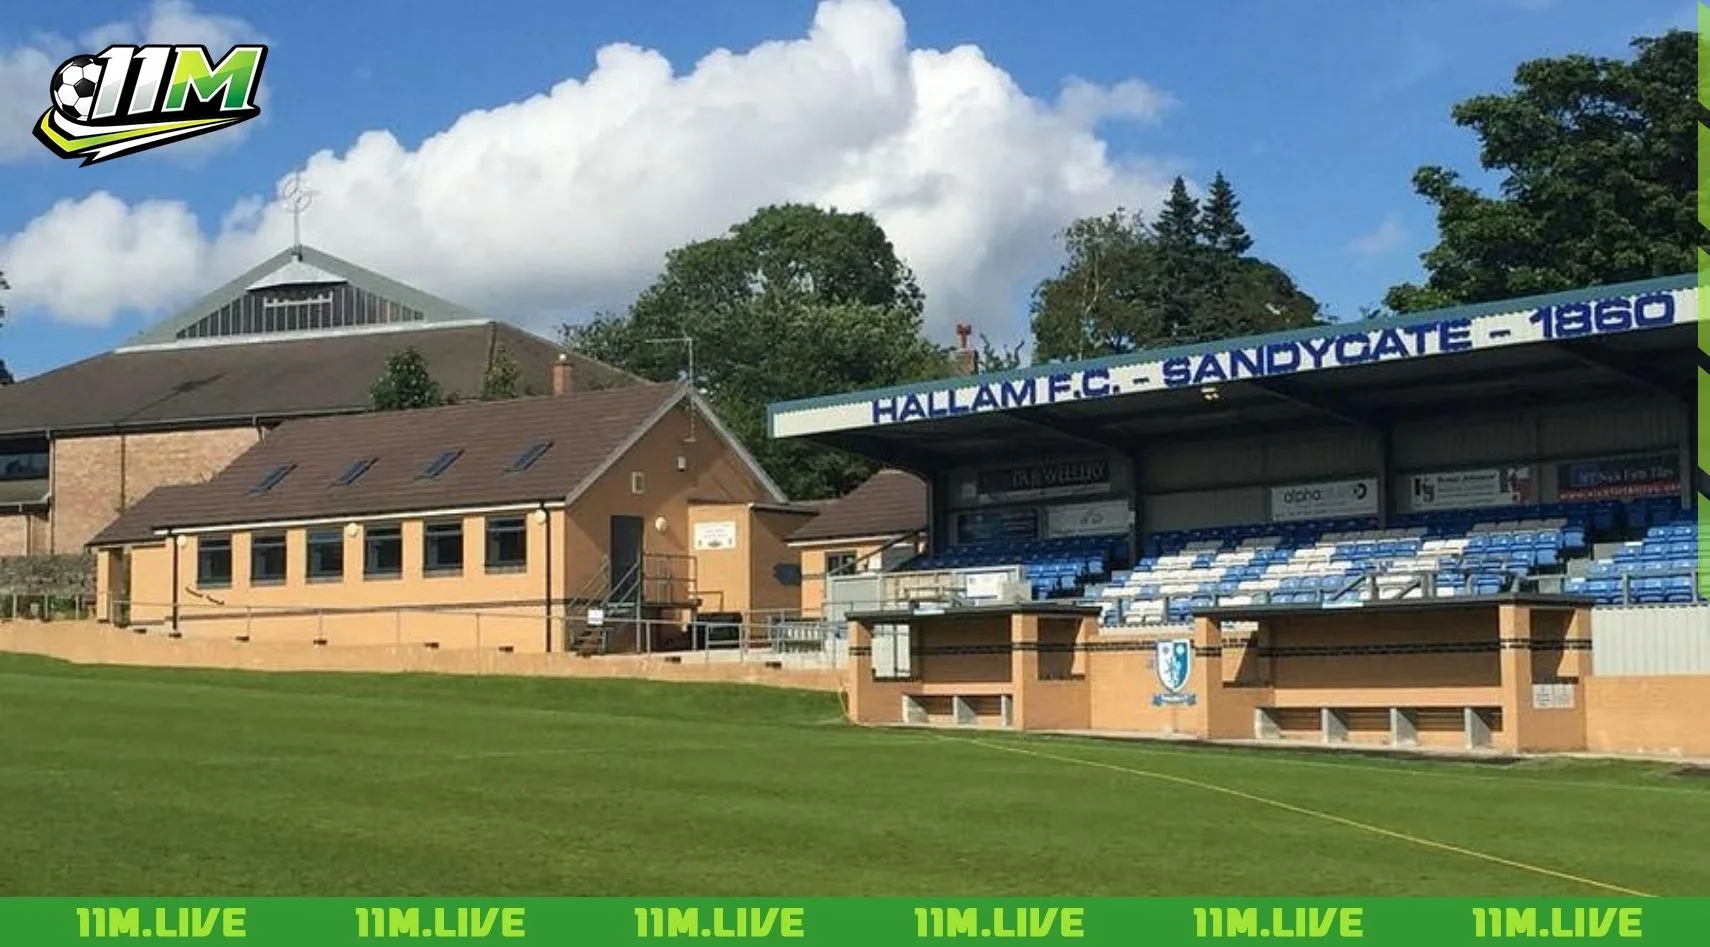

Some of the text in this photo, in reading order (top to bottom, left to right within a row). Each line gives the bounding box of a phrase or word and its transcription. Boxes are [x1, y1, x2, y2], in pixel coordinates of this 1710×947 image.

[872, 377, 1036, 424] HALLAM
[1048, 369, 1120, 403] F.C.
[1163, 318, 1473, 387] SANDYGATE
[1529, 293, 1676, 340] 1860
